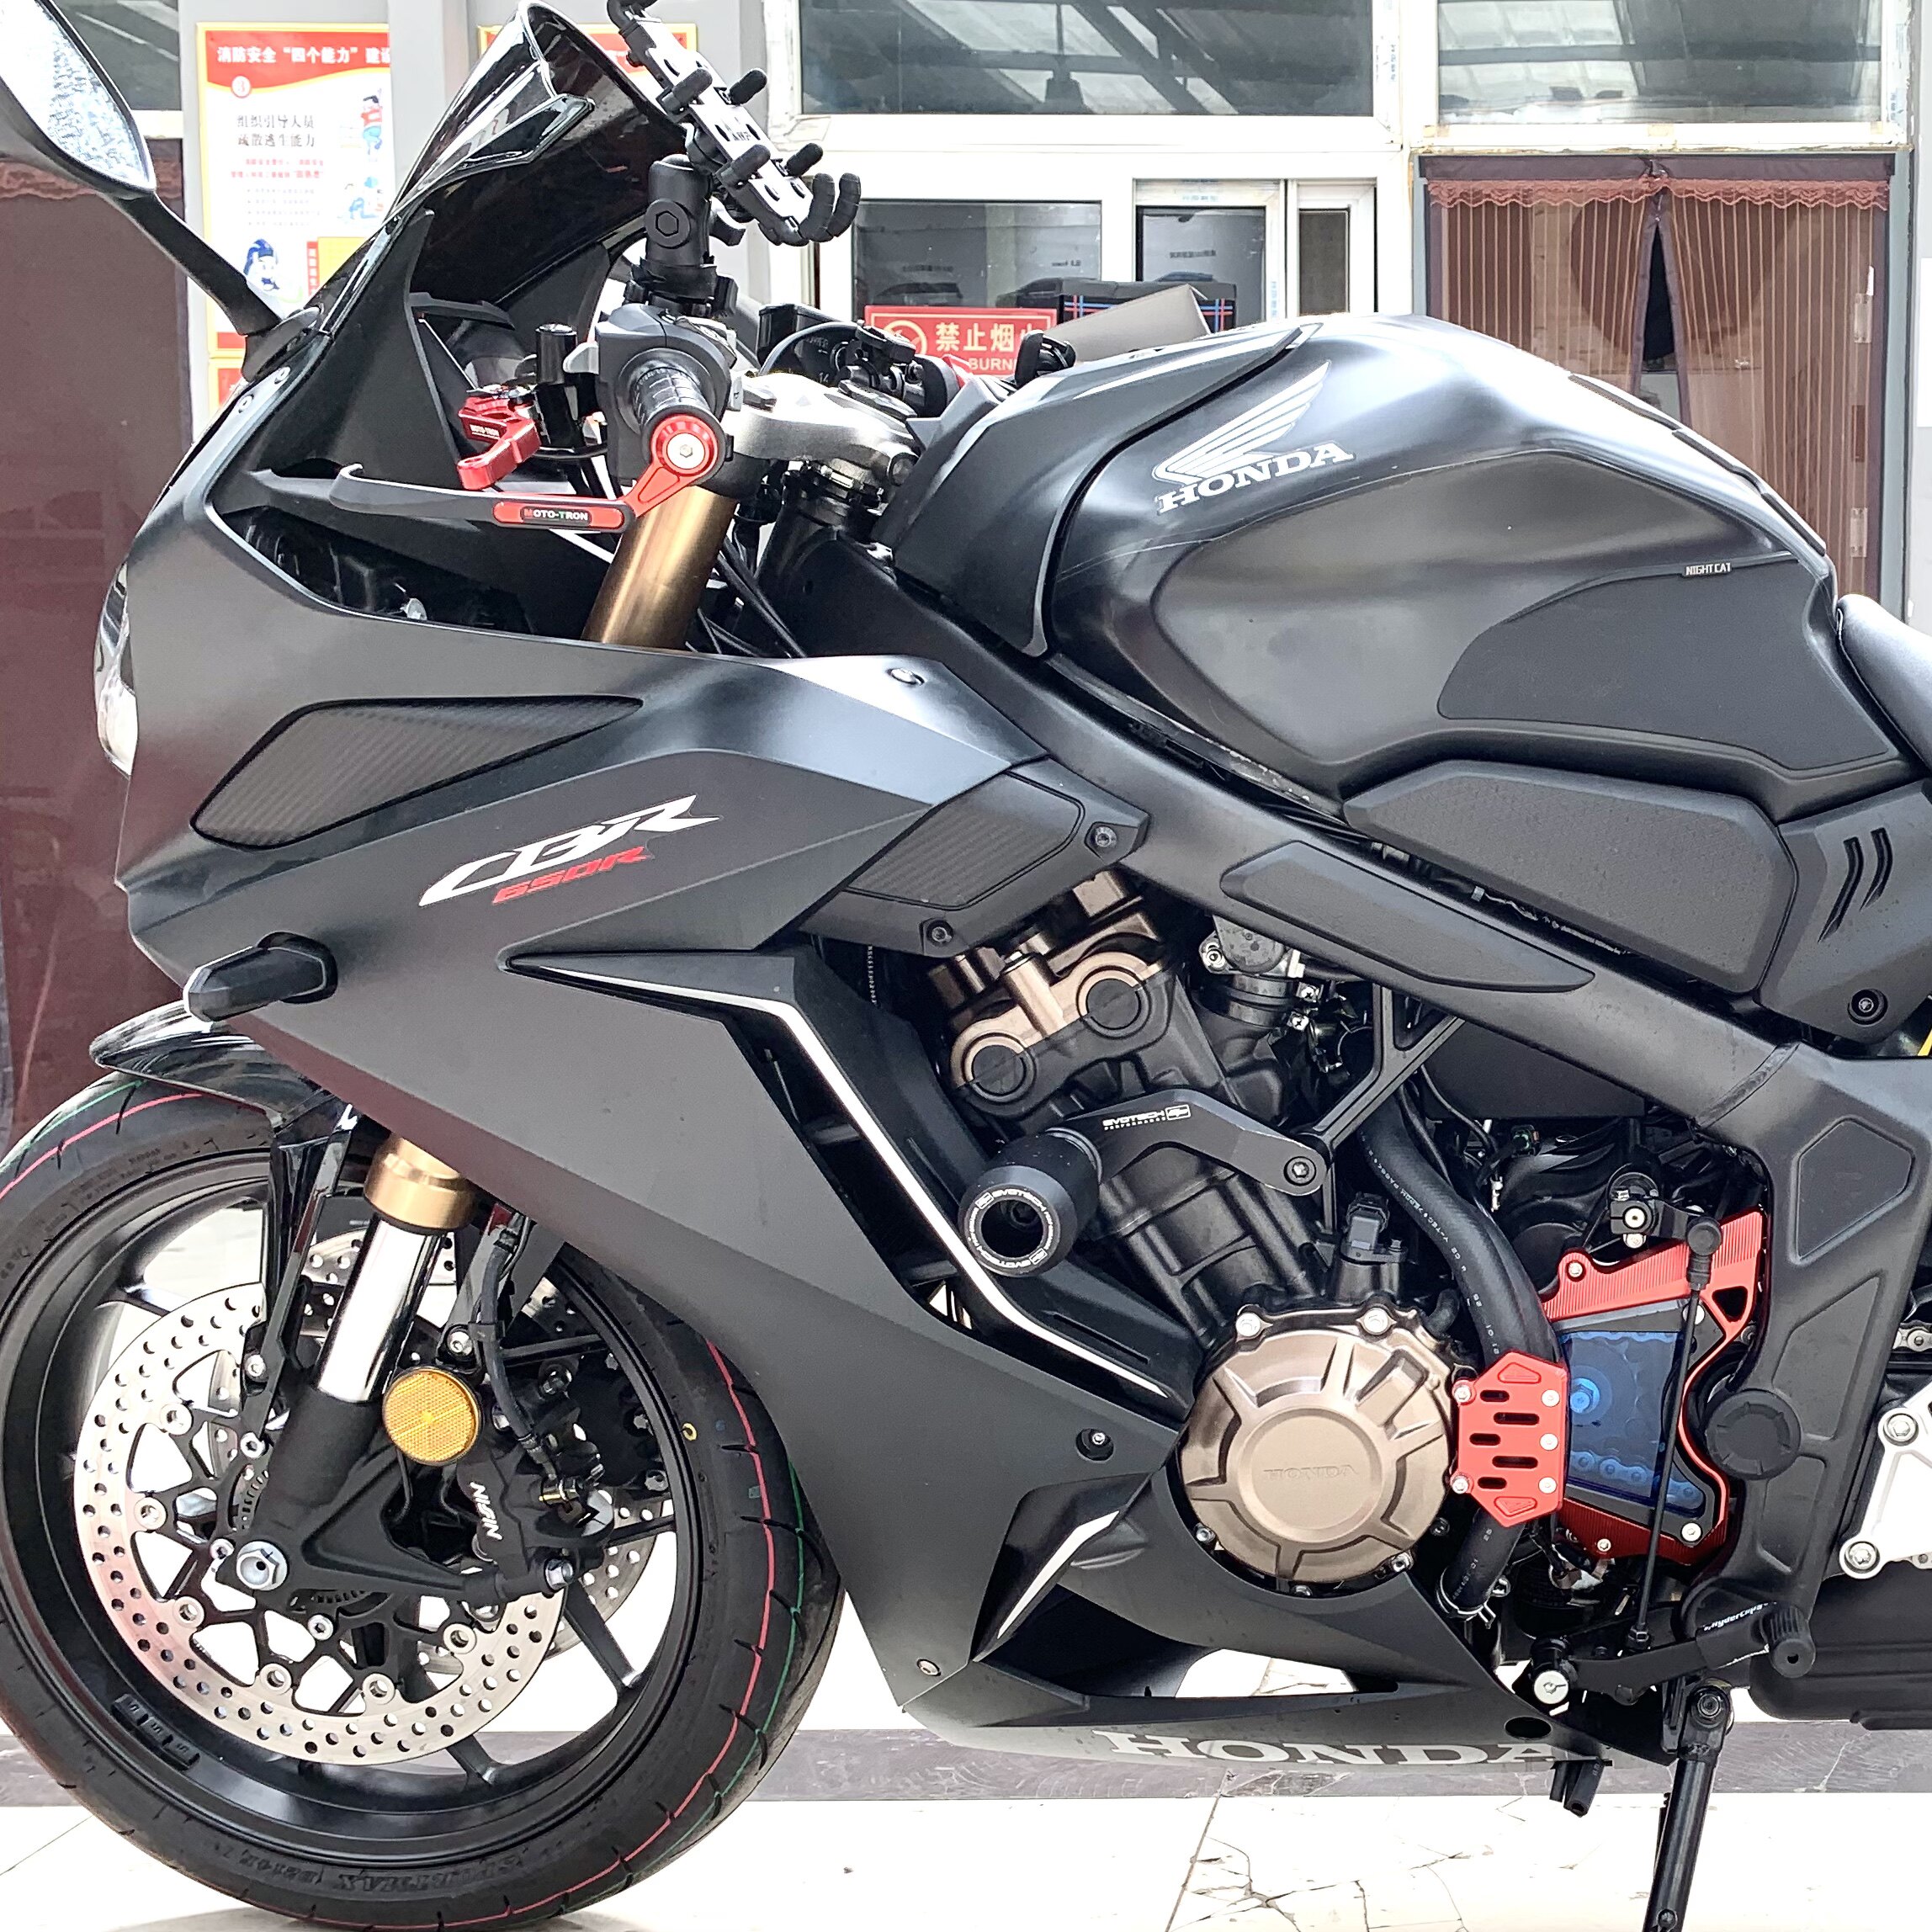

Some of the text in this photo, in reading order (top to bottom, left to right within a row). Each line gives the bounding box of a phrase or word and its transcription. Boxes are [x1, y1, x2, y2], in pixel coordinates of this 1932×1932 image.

[1158, 442, 1355, 514] HONDA
[523, 508, 588, 521] MOTO-TRON
[418, 794, 721, 907] CBR
[491, 846, 649, 905] 650R
[1093, 1730, 1554, 1765] HONDA
